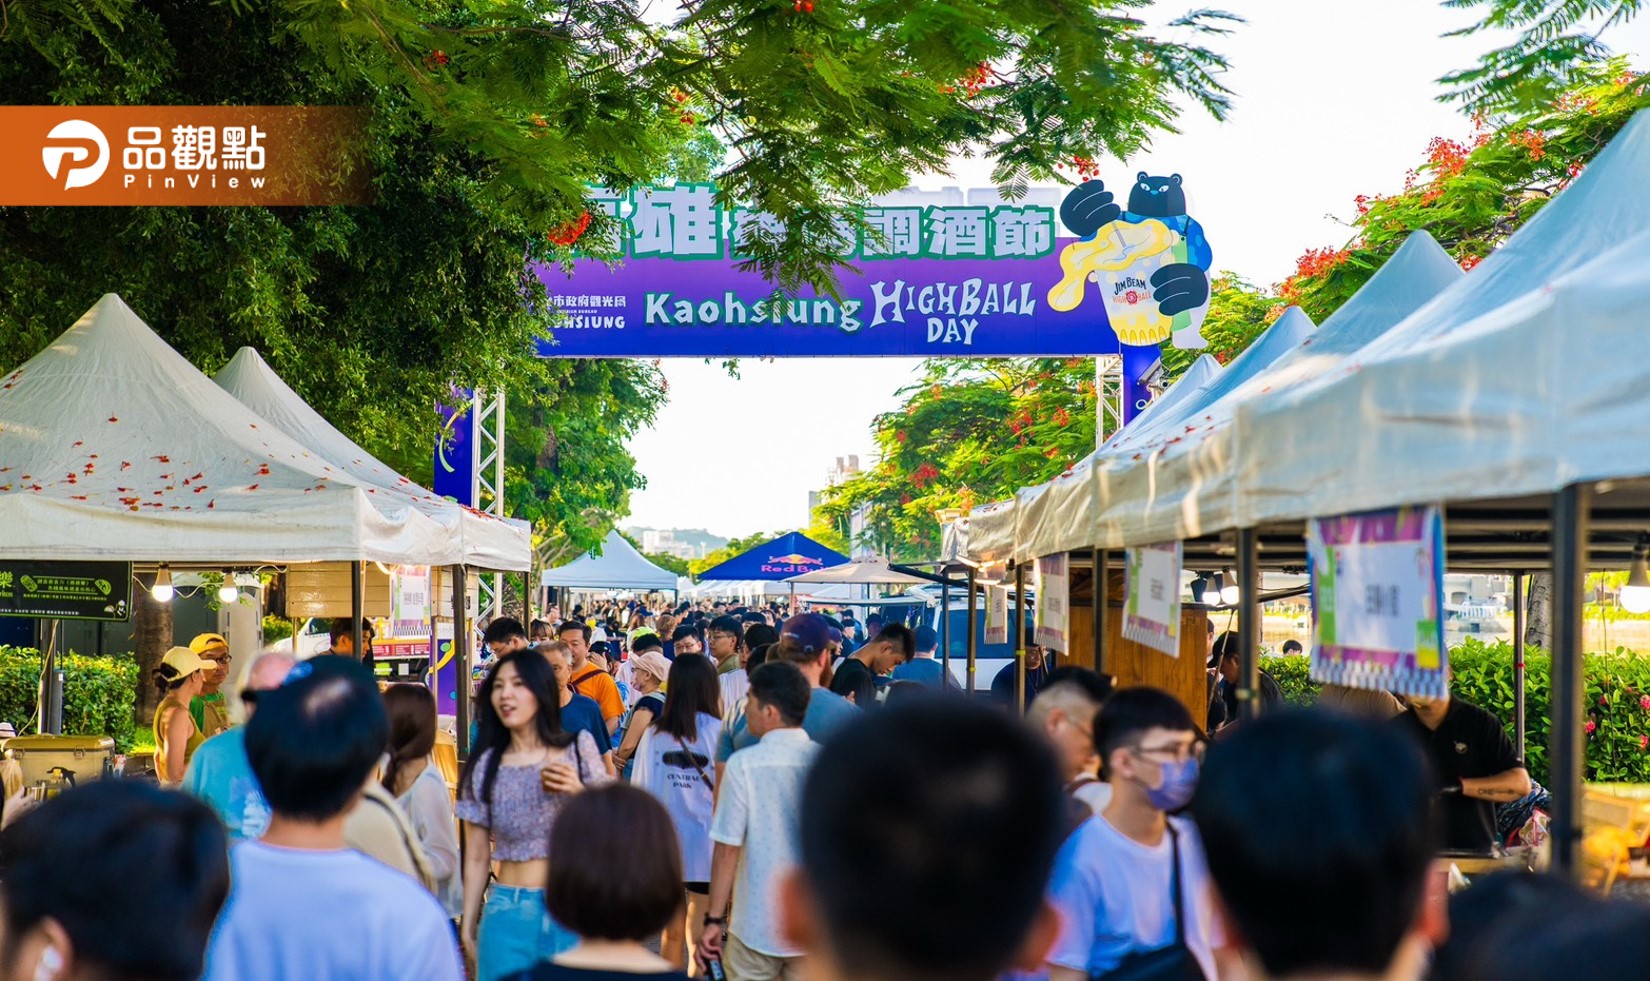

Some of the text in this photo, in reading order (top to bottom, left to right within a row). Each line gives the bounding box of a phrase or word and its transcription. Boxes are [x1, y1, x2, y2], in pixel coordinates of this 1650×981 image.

[1126, 277, 1146, 290] BEAM
[546, 294, 626, 307] 市政府觀光局
[645, 292, 863, 333] Kaohsiung
[926, 316, 979, 345] DAY
[761, 565, 795, 573] Red
